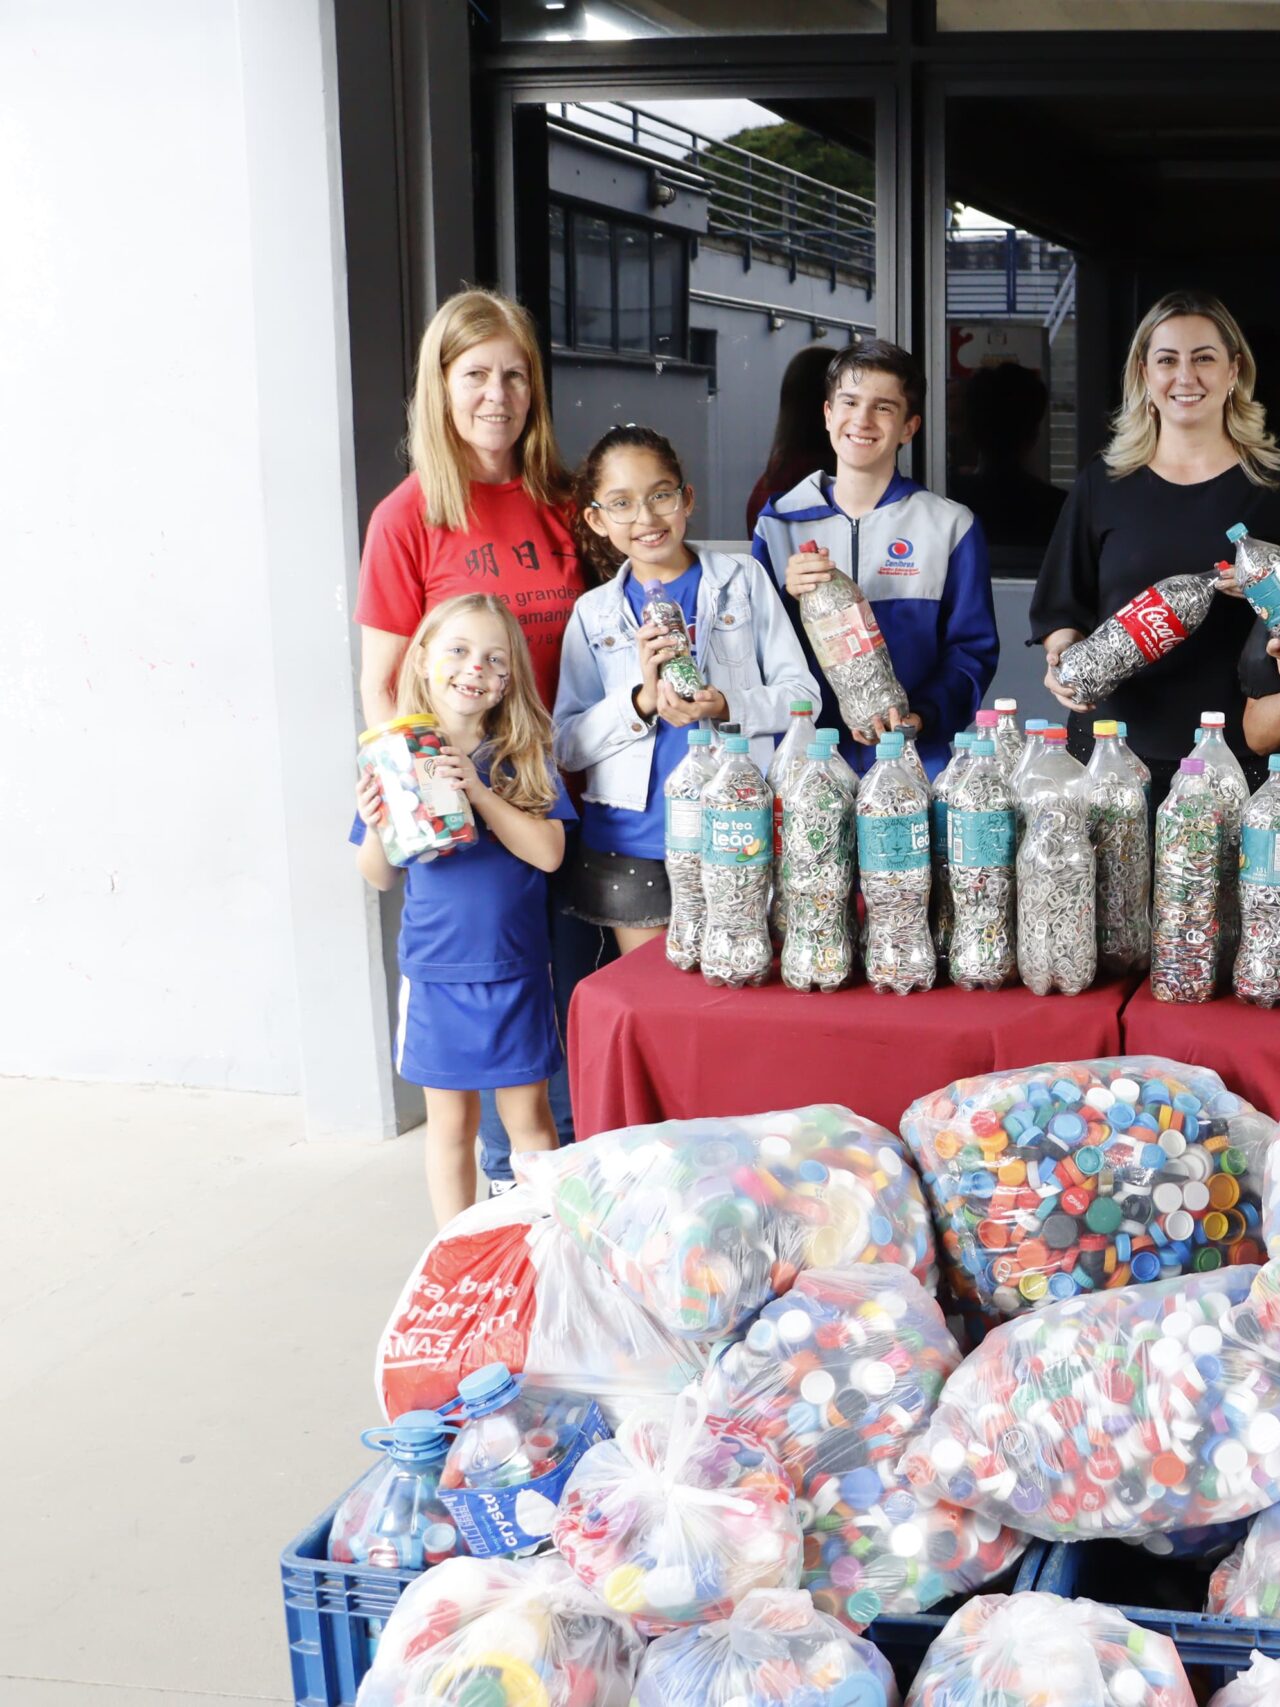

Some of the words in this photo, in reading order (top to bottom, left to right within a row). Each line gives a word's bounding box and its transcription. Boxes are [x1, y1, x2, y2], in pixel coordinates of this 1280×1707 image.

[518, 607, 571, 625] amanh
[712, 819, 730, 831] Ice
[731, 820, 752, 831] tea
[712, 830, 754, 848] leão
